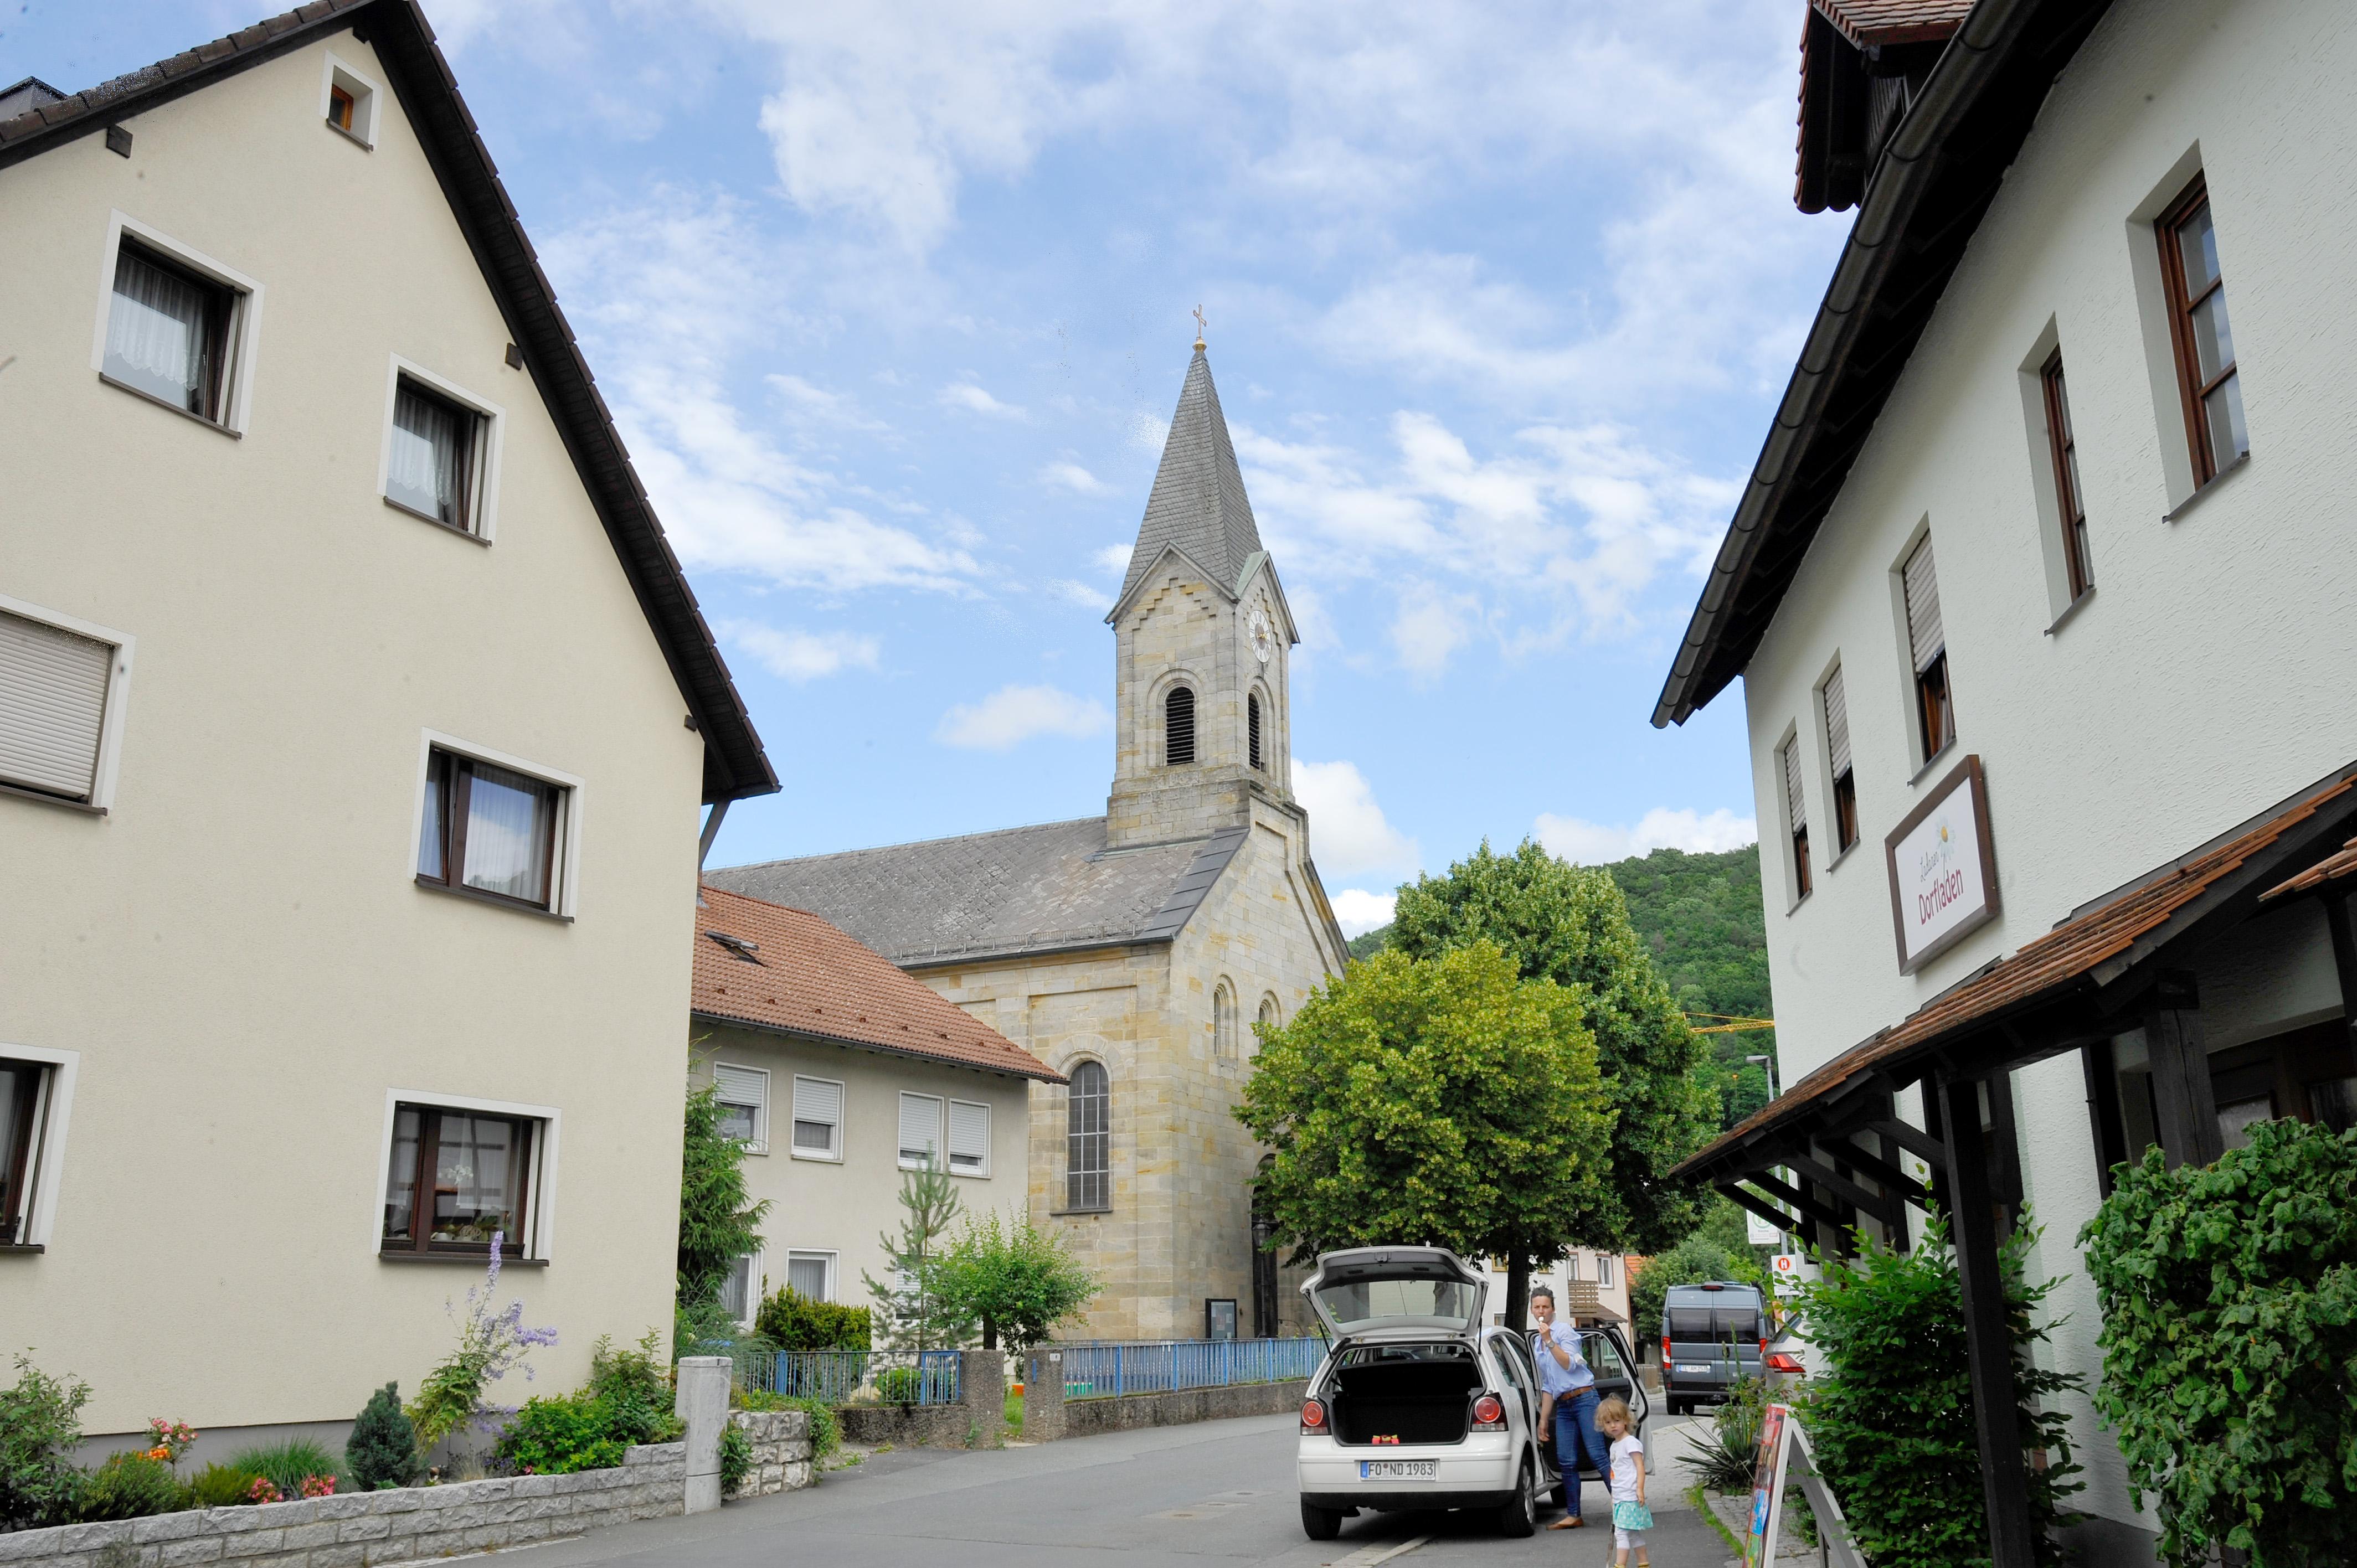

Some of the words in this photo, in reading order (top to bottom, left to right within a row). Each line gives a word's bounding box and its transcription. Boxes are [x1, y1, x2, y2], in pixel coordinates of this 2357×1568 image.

[1919, 869, 1963, 925] Dorfladen
[1780, 1260, 1788, 1269] H
[1368, 1463, 1382, 1476] FO
[1390, 1463, 1403, 1476] ND
[1406, 1463, 1433, 1476] 1983
